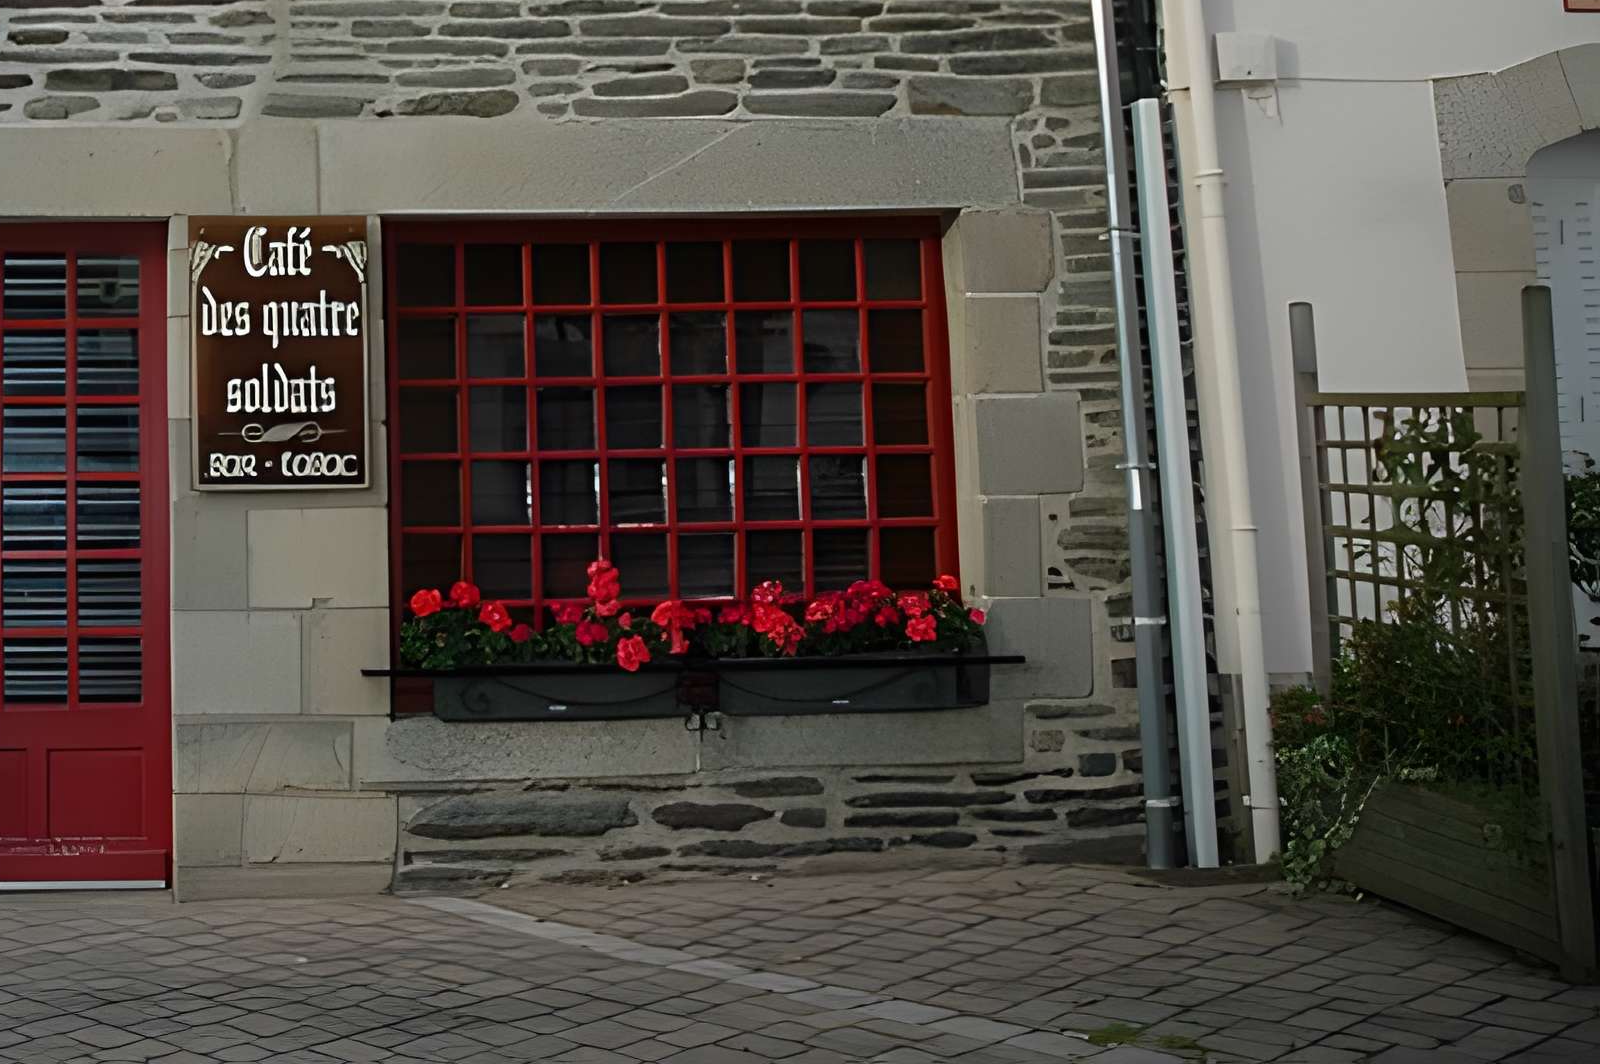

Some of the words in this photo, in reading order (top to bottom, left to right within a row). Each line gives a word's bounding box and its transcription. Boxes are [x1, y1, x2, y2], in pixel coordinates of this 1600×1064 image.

[243, 226, 312, 277] Café
[202, 286, 250, 336] des
[262, 290, 360, 349] quatre
[226, 363, 336, 413] soldats
